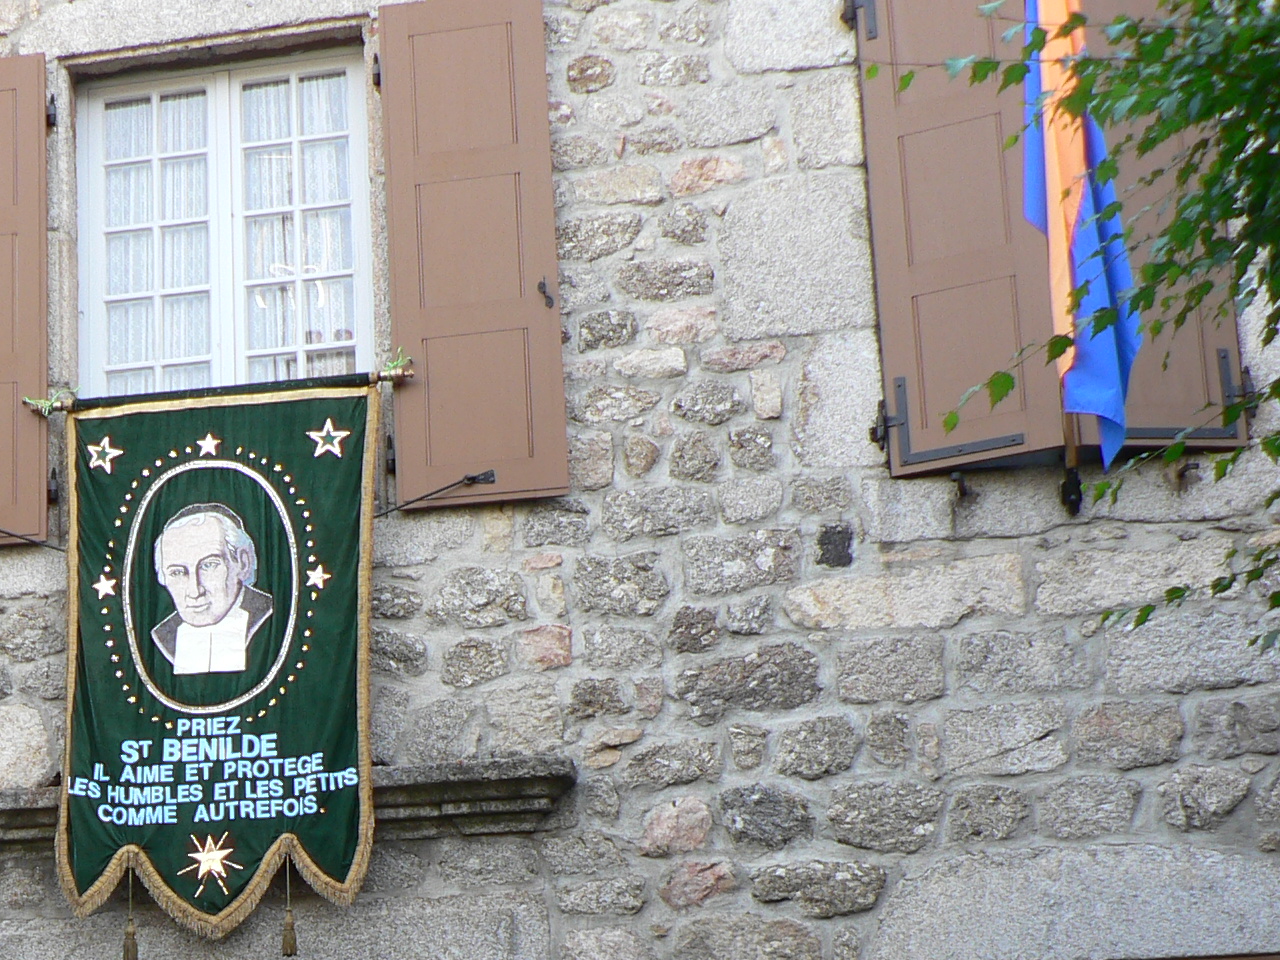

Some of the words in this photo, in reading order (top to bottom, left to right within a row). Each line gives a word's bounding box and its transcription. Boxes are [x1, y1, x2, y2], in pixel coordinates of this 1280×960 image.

[176, 716, 241, 737] PRIEZ
[162, 733, 278, 762] BENILDE
[93, 763, 110, 782] IL
[120, 764, 174, 783] AIME
[184, 762, 213, 781] ET
[223, 752, 324, 779] PROTEGE
[68, 776, 101, 798] LES
[107, 784, 203, 805] HUMBLES
[213, 781, 239, 800] ET
[245, 779, 283, 799] LES
[293, 767, 359, 796] PETITS
[97, 804, 177, 826] COMME
